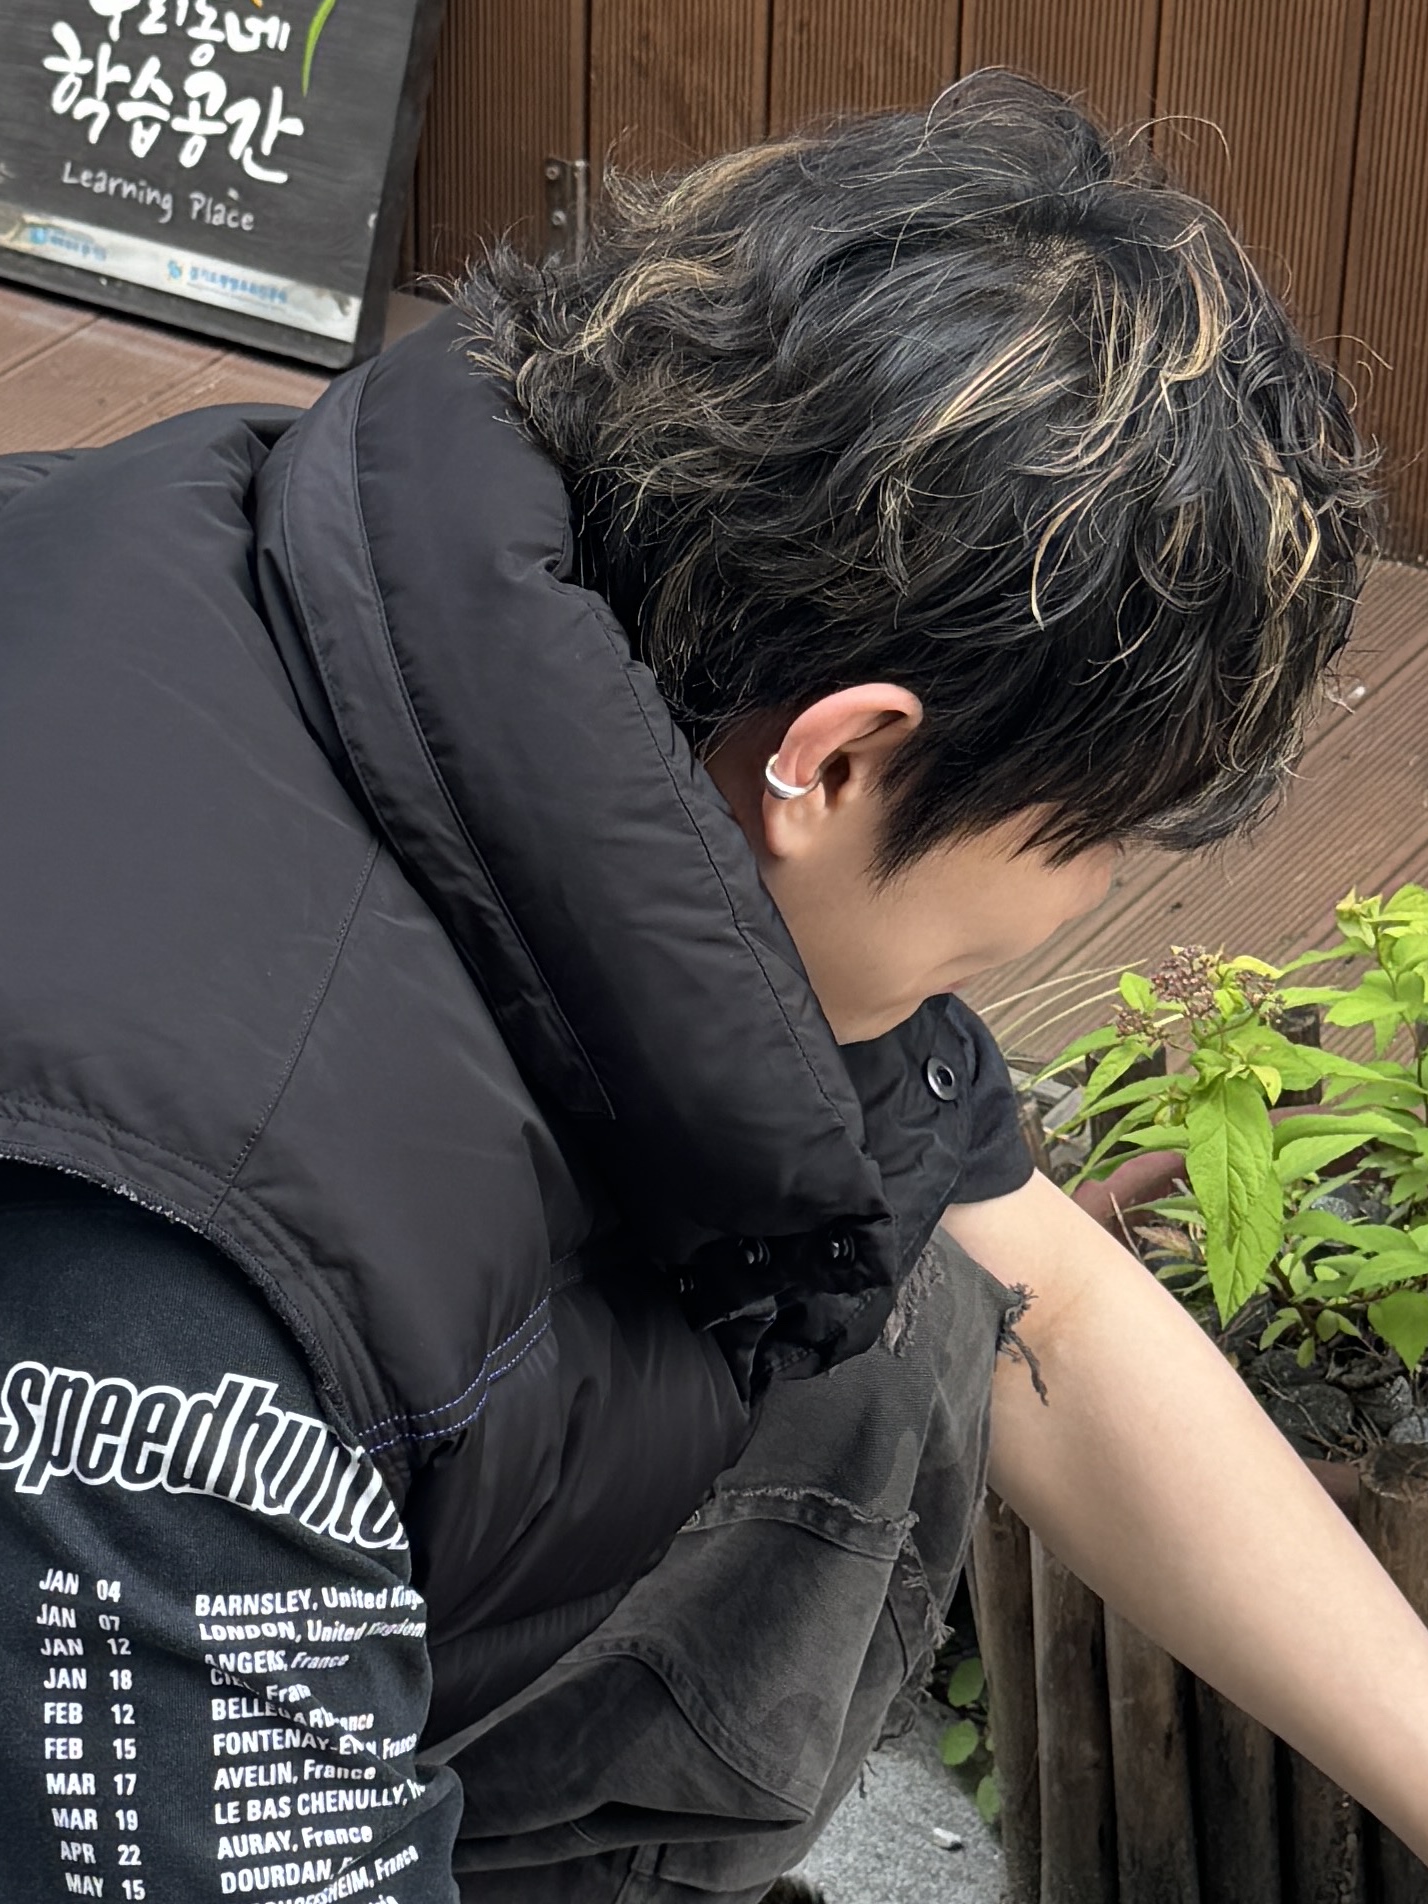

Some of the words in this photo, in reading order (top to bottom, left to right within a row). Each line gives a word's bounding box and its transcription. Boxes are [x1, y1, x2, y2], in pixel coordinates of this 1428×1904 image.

[42, 21, 305, 185] 학습공간
[61, 160, 175, 225] Learning
[188, 187, 256, 233] Place
[39, 1568, 79, 1595] JAN
[96, 1579, 121, 1603] 04
[195, 1587, 318, 1617] BARNSLEY,
[322, 1586, 387, 1610] United
[36, 1603, 77, 1628] JAN
[98, 1614, 120, 1631] 07
[199, 1620, 302, 1644] LONDON,
[307, 1619, 367, 1643] United
[40, 1638, 84, 1657] JAN
[107, 1638, 131, 1656] 12
[290, 1651, 350, 1670] France
[43, 1667, 87, 1690] JAN
[109, 1669, 133, 1691] 18
[44, 1702, 83, 1724] FEB
[110, 1703, 136, 1725] 12
[44, 1737, 84, 1760] FEB
[112, 1738, 137, 1760] 15
[45, 1773, 96, 1796] MAR
[113, 1773, 137, 1796] 17
[214, 1760, 298, 1790] AVELIN,
[303, 1759, 376, 1781] France
[51, 1807, 98, 1831] MAR
[115, 1809, 138, 1831] 19
[215, 1801, 241, 1825] LE
[247, 1795, 291, 1822] BAS
[297, 1783, 408, 1816] CHENULLY,
[60, 1840, 97, 1864] APR
[117, 1844, 142, 1866] 22
[217, 1829, 299, 1860] AURAY,
[301, 1824, 373, 1851] France
[374, 1845, 419, 1881] France
[64, 1872, 104, 1898] MAY
[121, 1878, 146, 1901] 15
[220, 1859, 335, 1894] DOURDAN,
